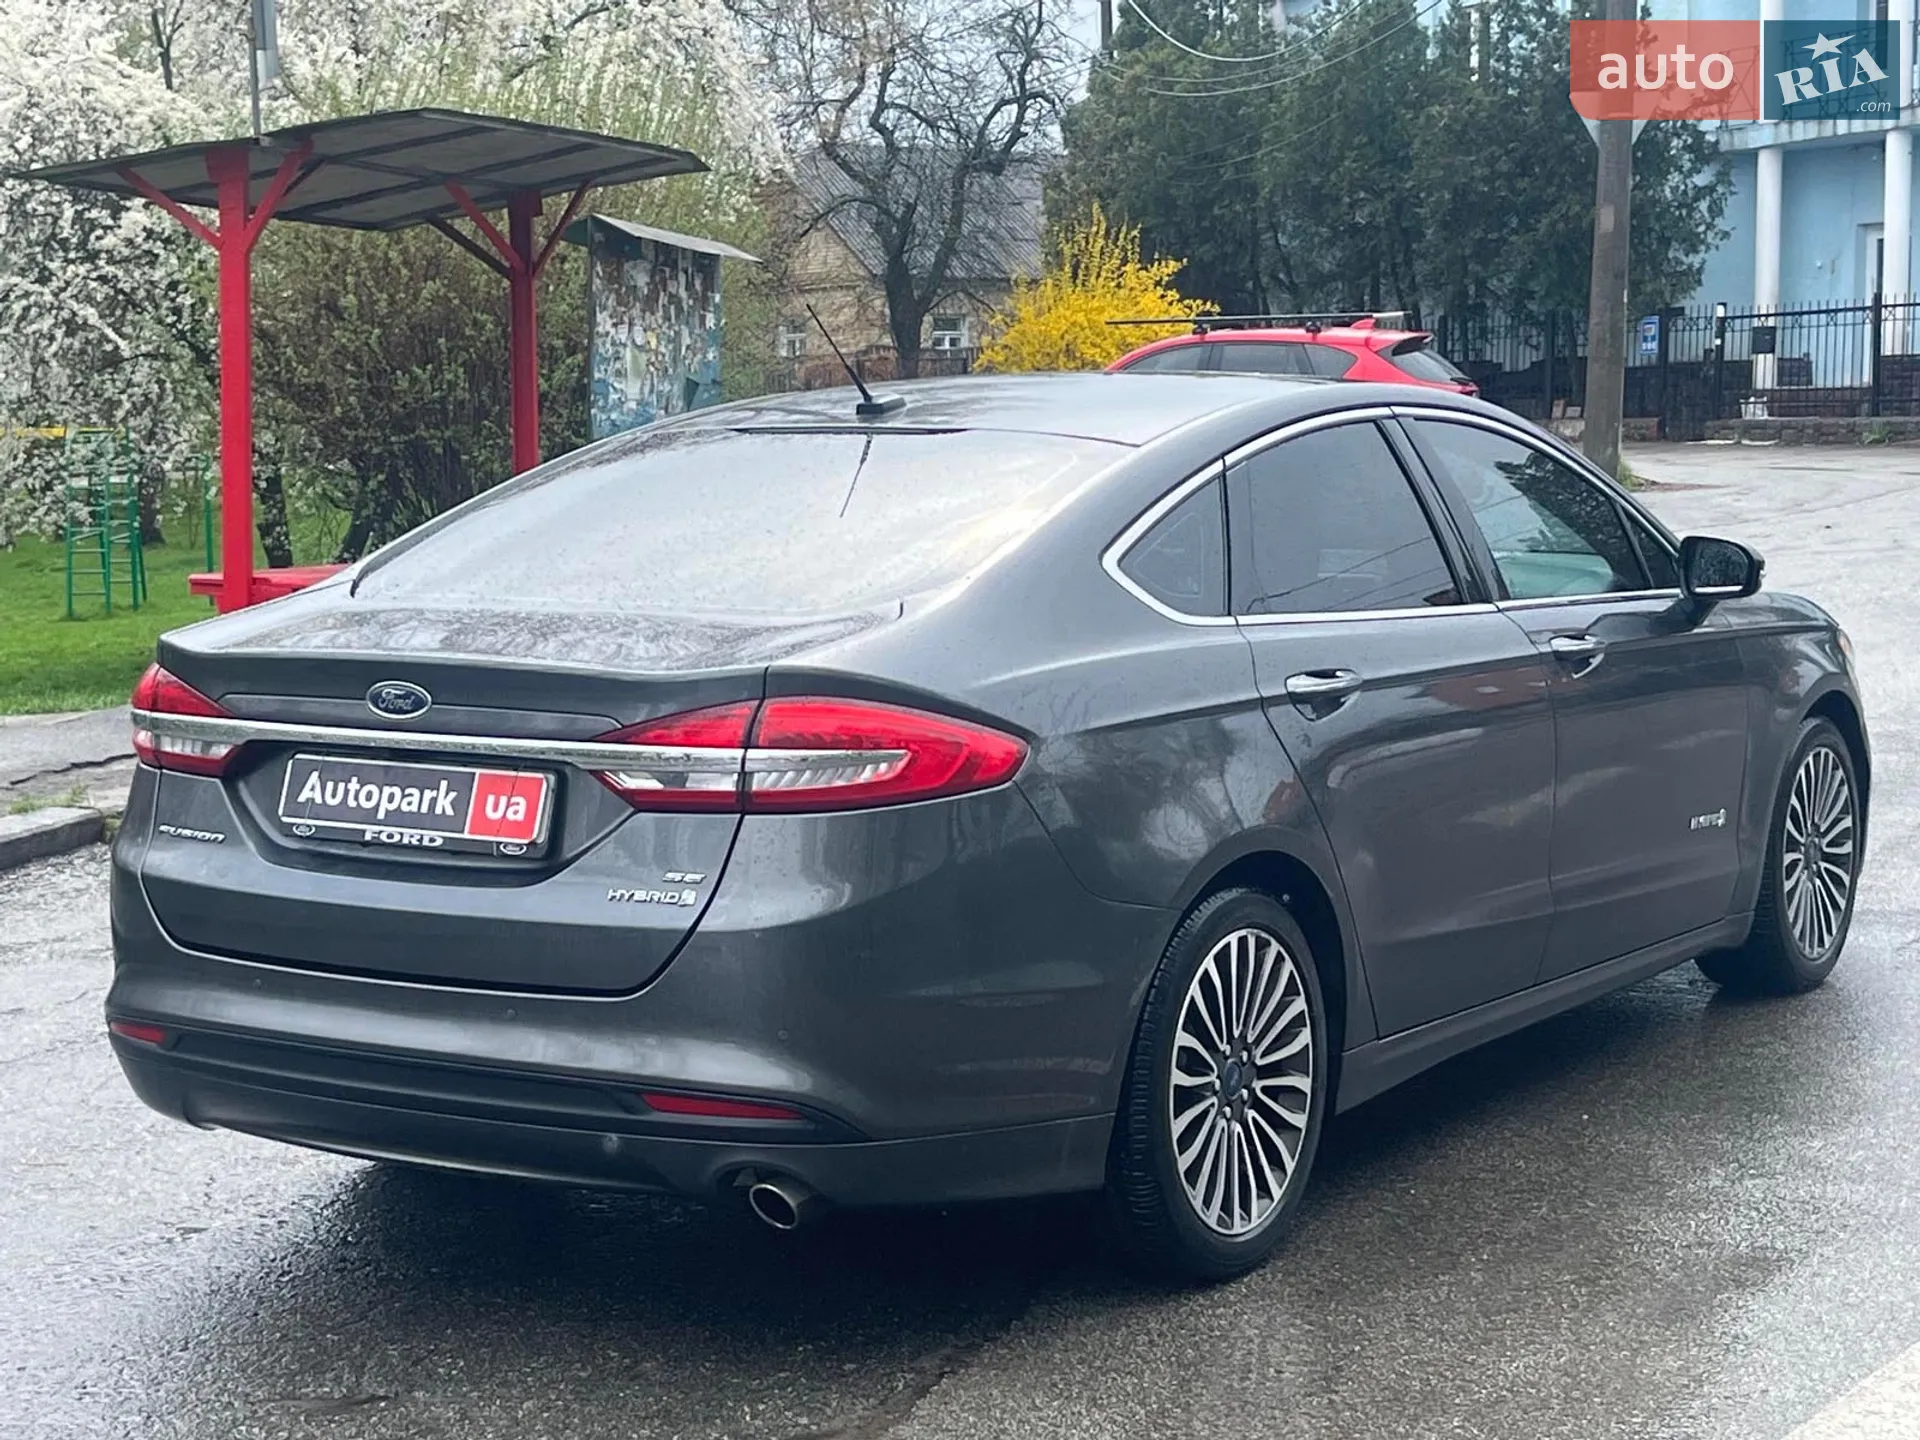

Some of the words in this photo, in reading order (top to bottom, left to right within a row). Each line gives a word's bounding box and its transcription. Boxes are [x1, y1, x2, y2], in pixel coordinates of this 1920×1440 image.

[378, 688, 416, 711] Ford
[296, 770, 459, 820] Autopark
[484, 792, 527, 821] ua
[158, 824, 226, 843] FUSION
[363, 829, 444, 848] FORD
[662, 871, 707, 884] SE
[607, 888, 680, 905] HYBRID
